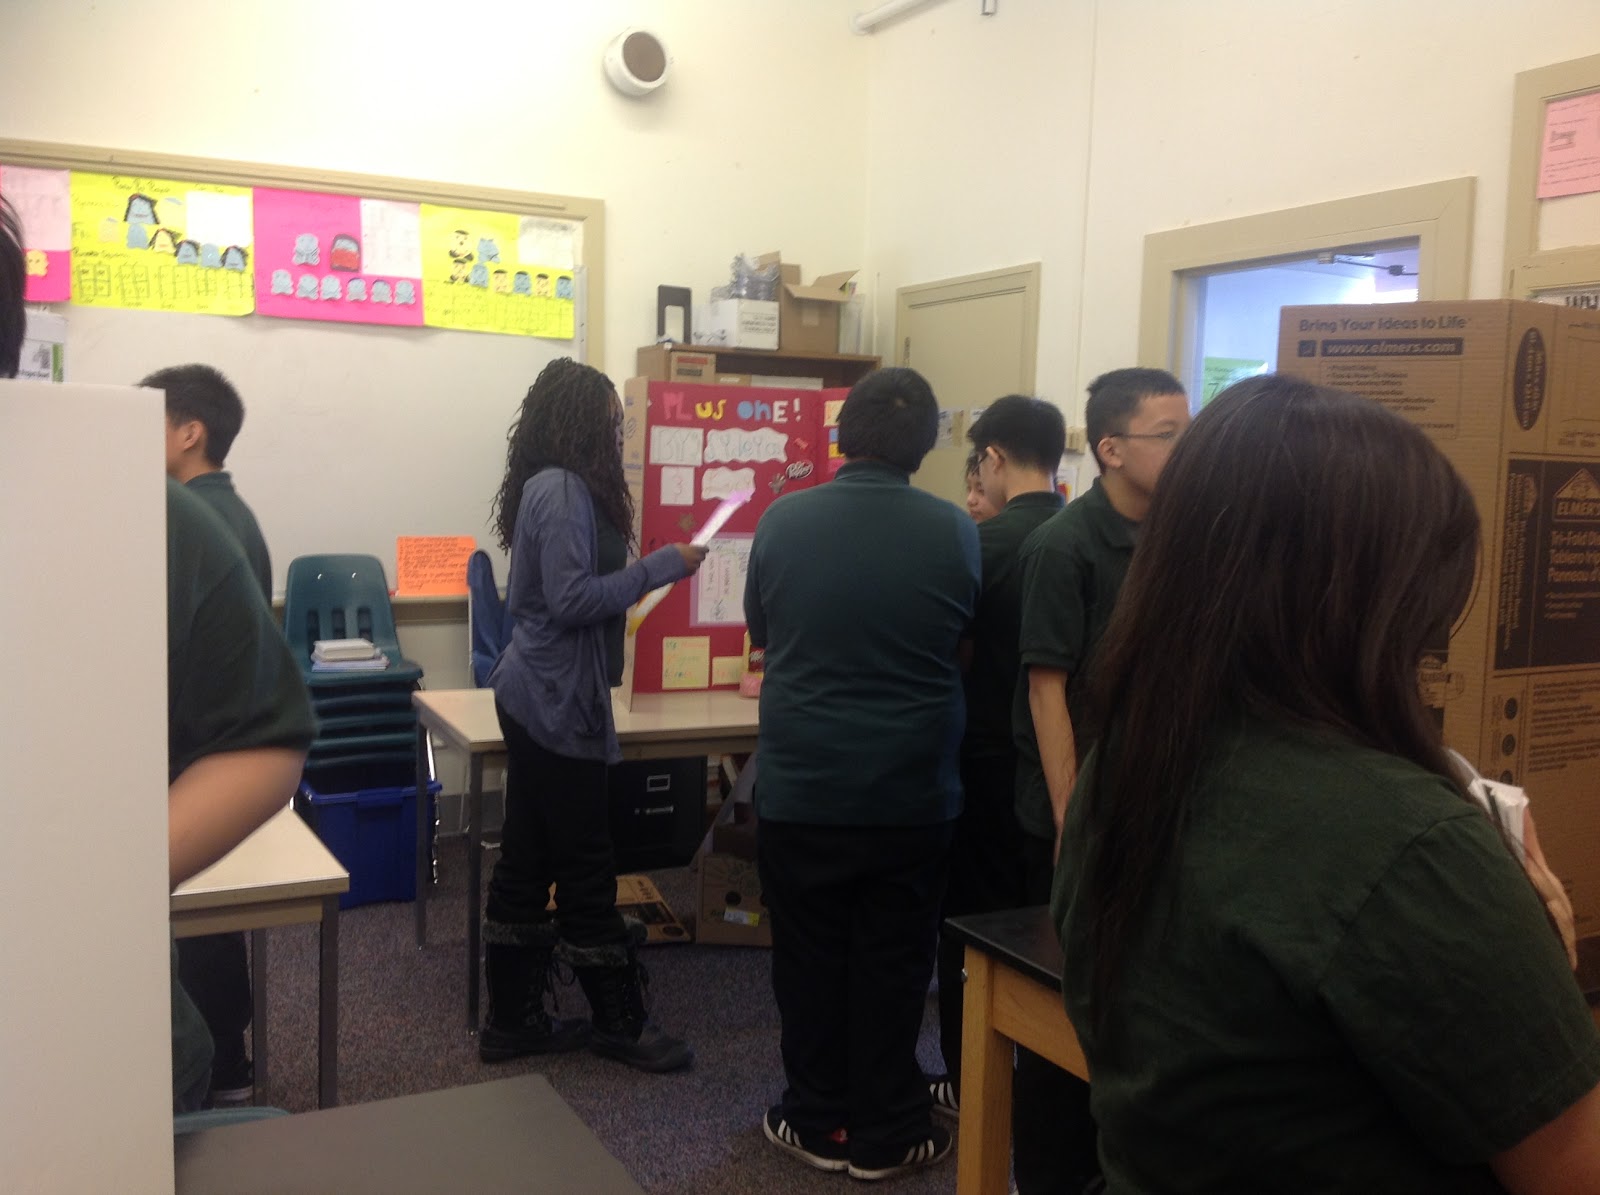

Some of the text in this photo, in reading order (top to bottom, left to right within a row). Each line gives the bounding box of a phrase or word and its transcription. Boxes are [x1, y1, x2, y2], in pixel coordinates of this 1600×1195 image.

[1299, 315, 1466, 333] Bring Your Ideas to Life
[1325, 341, 1457, 355] www.elmers.com
